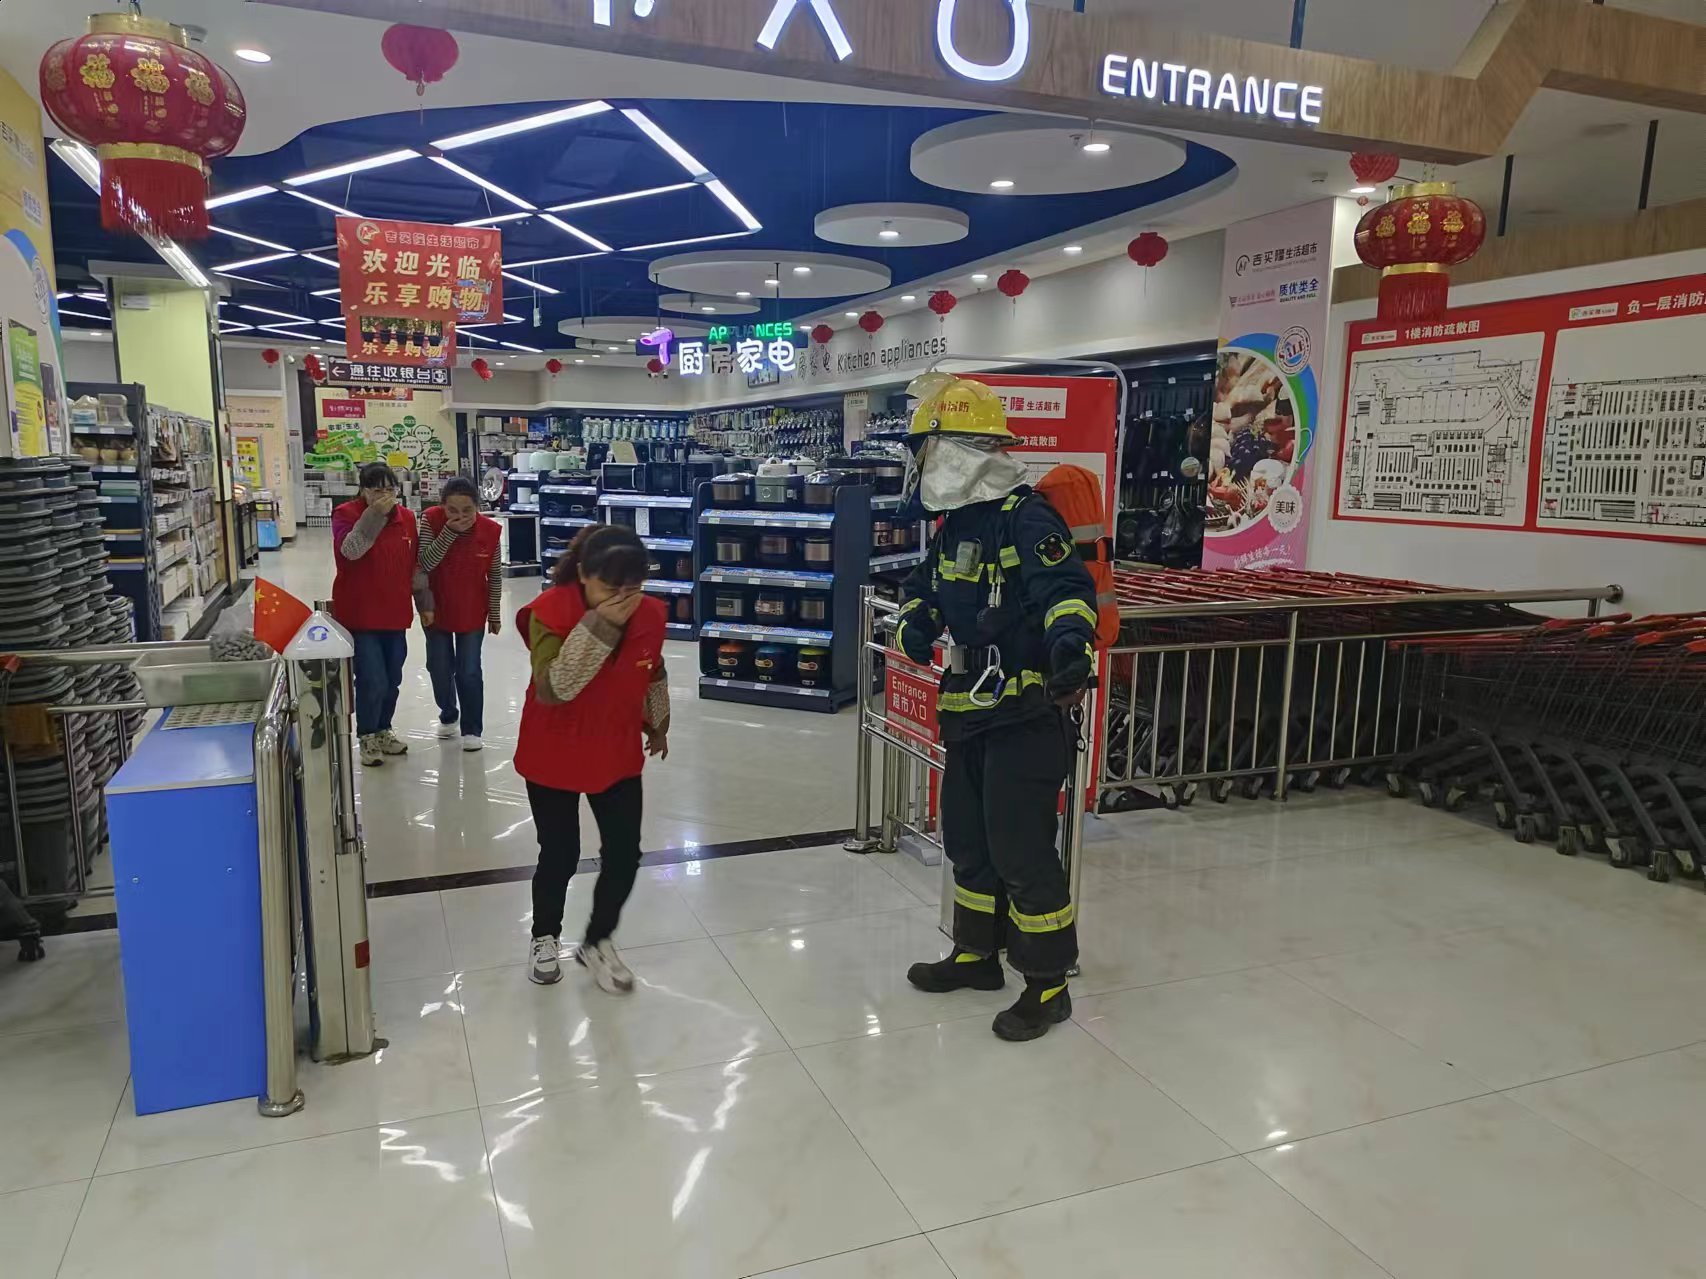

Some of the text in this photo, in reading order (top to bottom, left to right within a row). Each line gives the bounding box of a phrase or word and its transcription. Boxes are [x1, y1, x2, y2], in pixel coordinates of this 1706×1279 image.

[1102, 54, 1323, 124] ENTRANCE
[361, 249, 482, 280] 欢迎光临
[363, 282, 483, 311] 乐享购物
[1279, 278, 1319, 297] 质优类全
[1626, 290, 1706, 314] 负一层消防
[708, 322, 793, 339] APPLIANCES
[1404, 320, 1480, 339] 1楼消防疏散图
[678, 336, 796, 376] 厨房家电
[836, 335, 947, 371] Kitchen appliances
[350, 364, 430, 380] 通往收银台
[1275, 501, 1295, 514] 美味
[892, 675, 927, 701] Entrance
[892, 693, 927, 721] 超市入口
